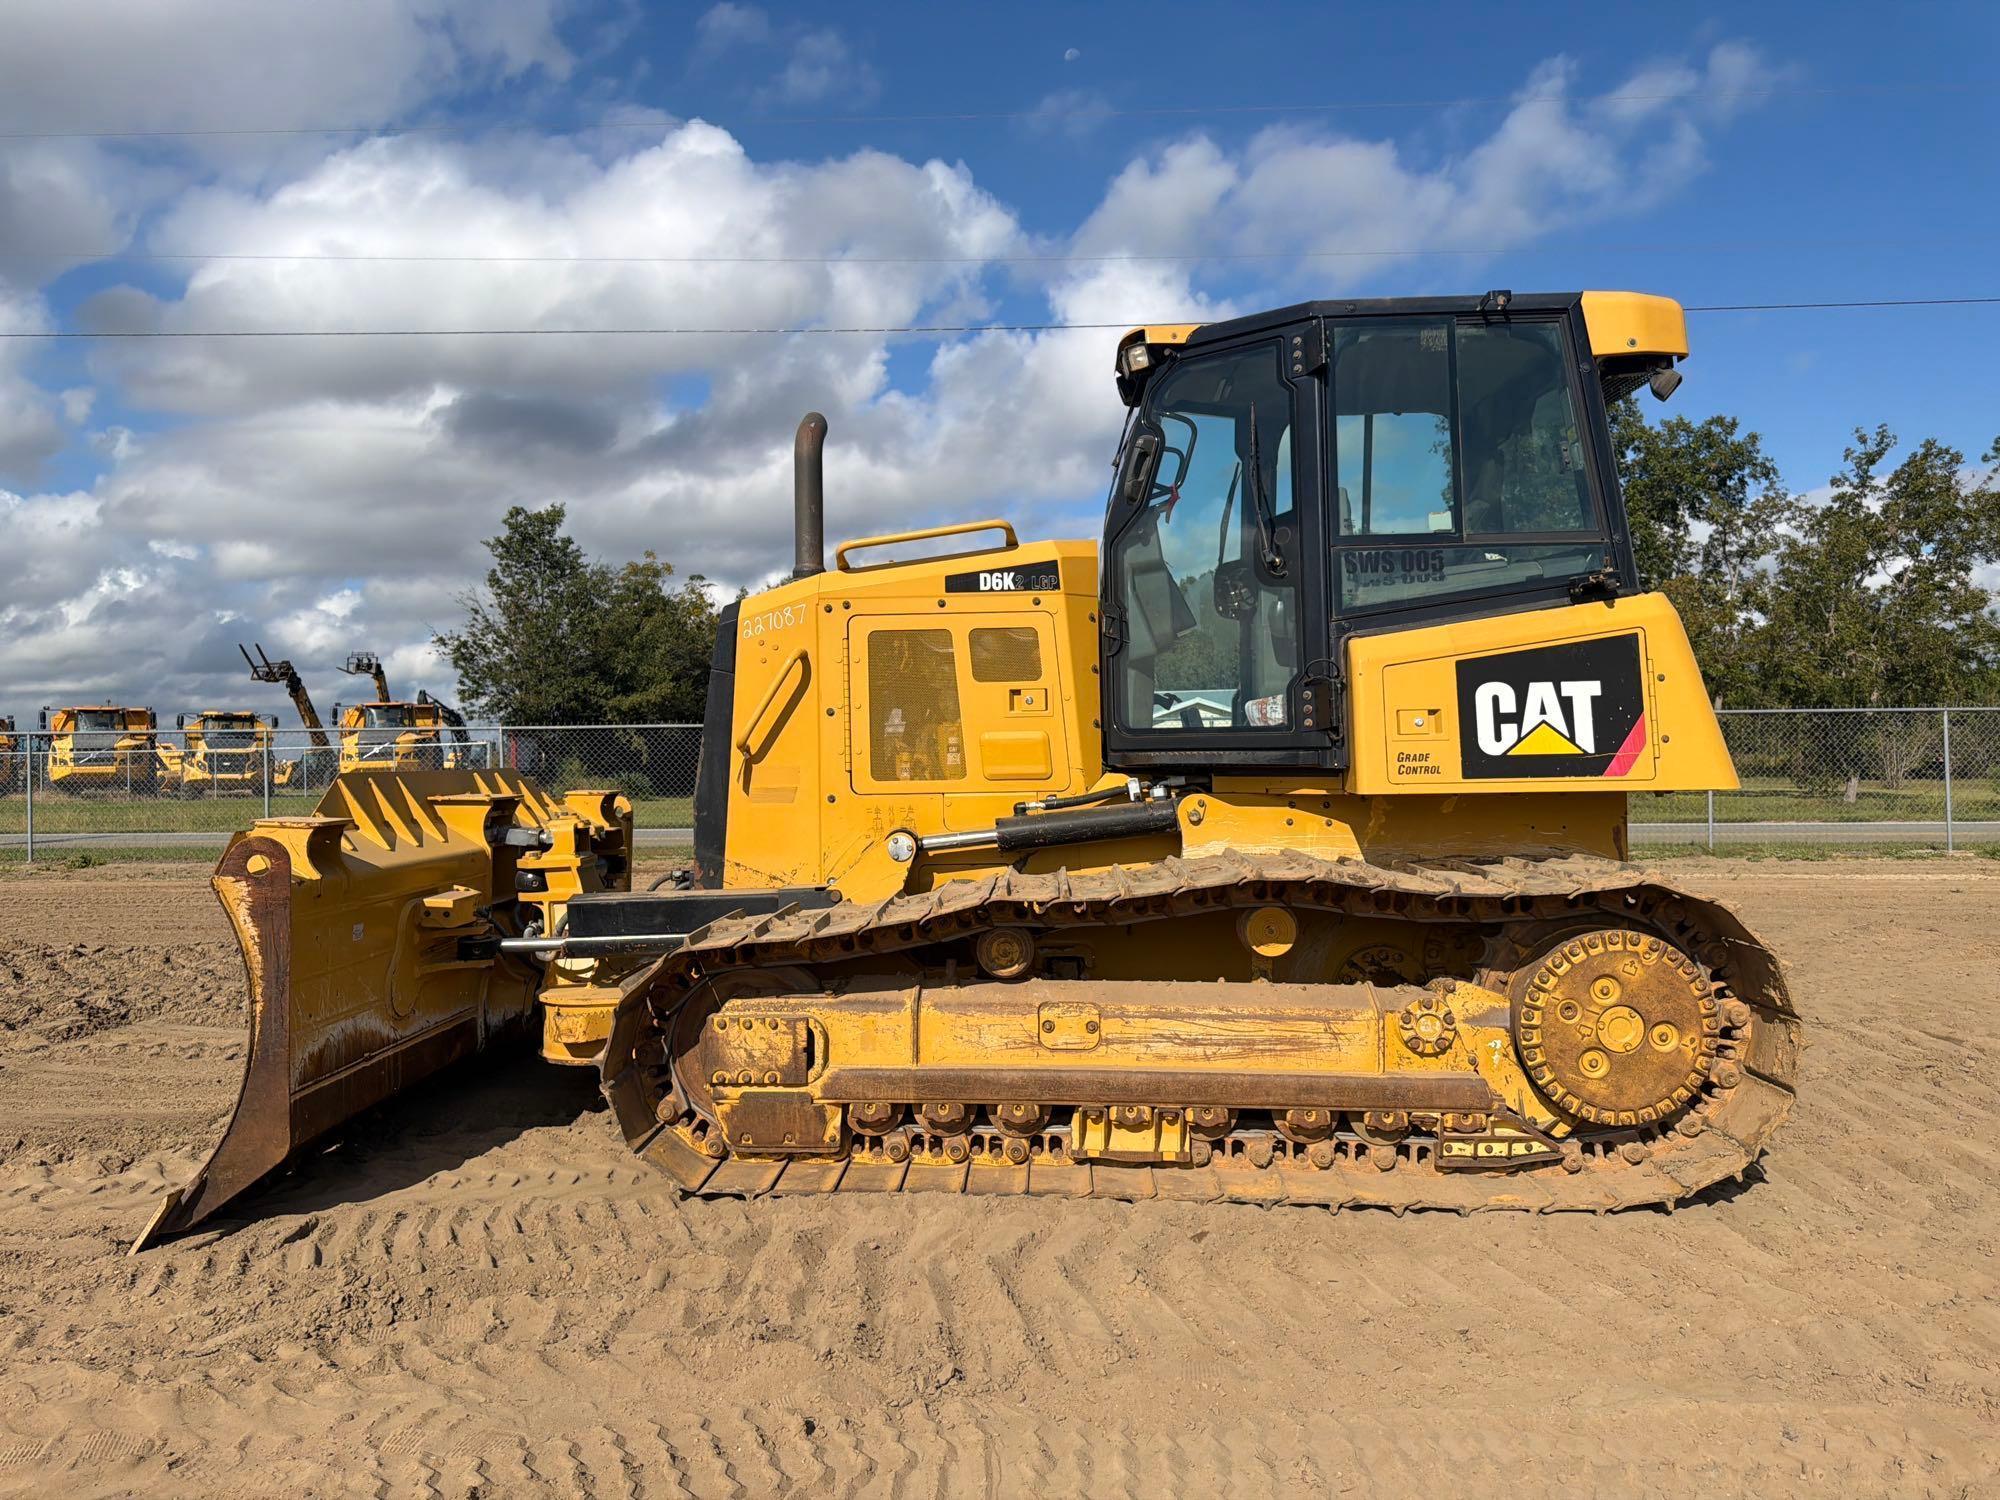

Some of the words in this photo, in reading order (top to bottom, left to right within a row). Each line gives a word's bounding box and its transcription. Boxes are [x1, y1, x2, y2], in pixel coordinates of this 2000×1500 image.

[1344, 550, 1394, 574] SWS
[1400, 550, 1445, 572] 005
[1031, 575, 1058, 590] LGP
[743, 603, 806, 639] 227087
[1475, 680, 1602, 756] CAT
[1397, 751, 1430, 763] GRADE
[1397, 764, 1441, 775] CONTROL
